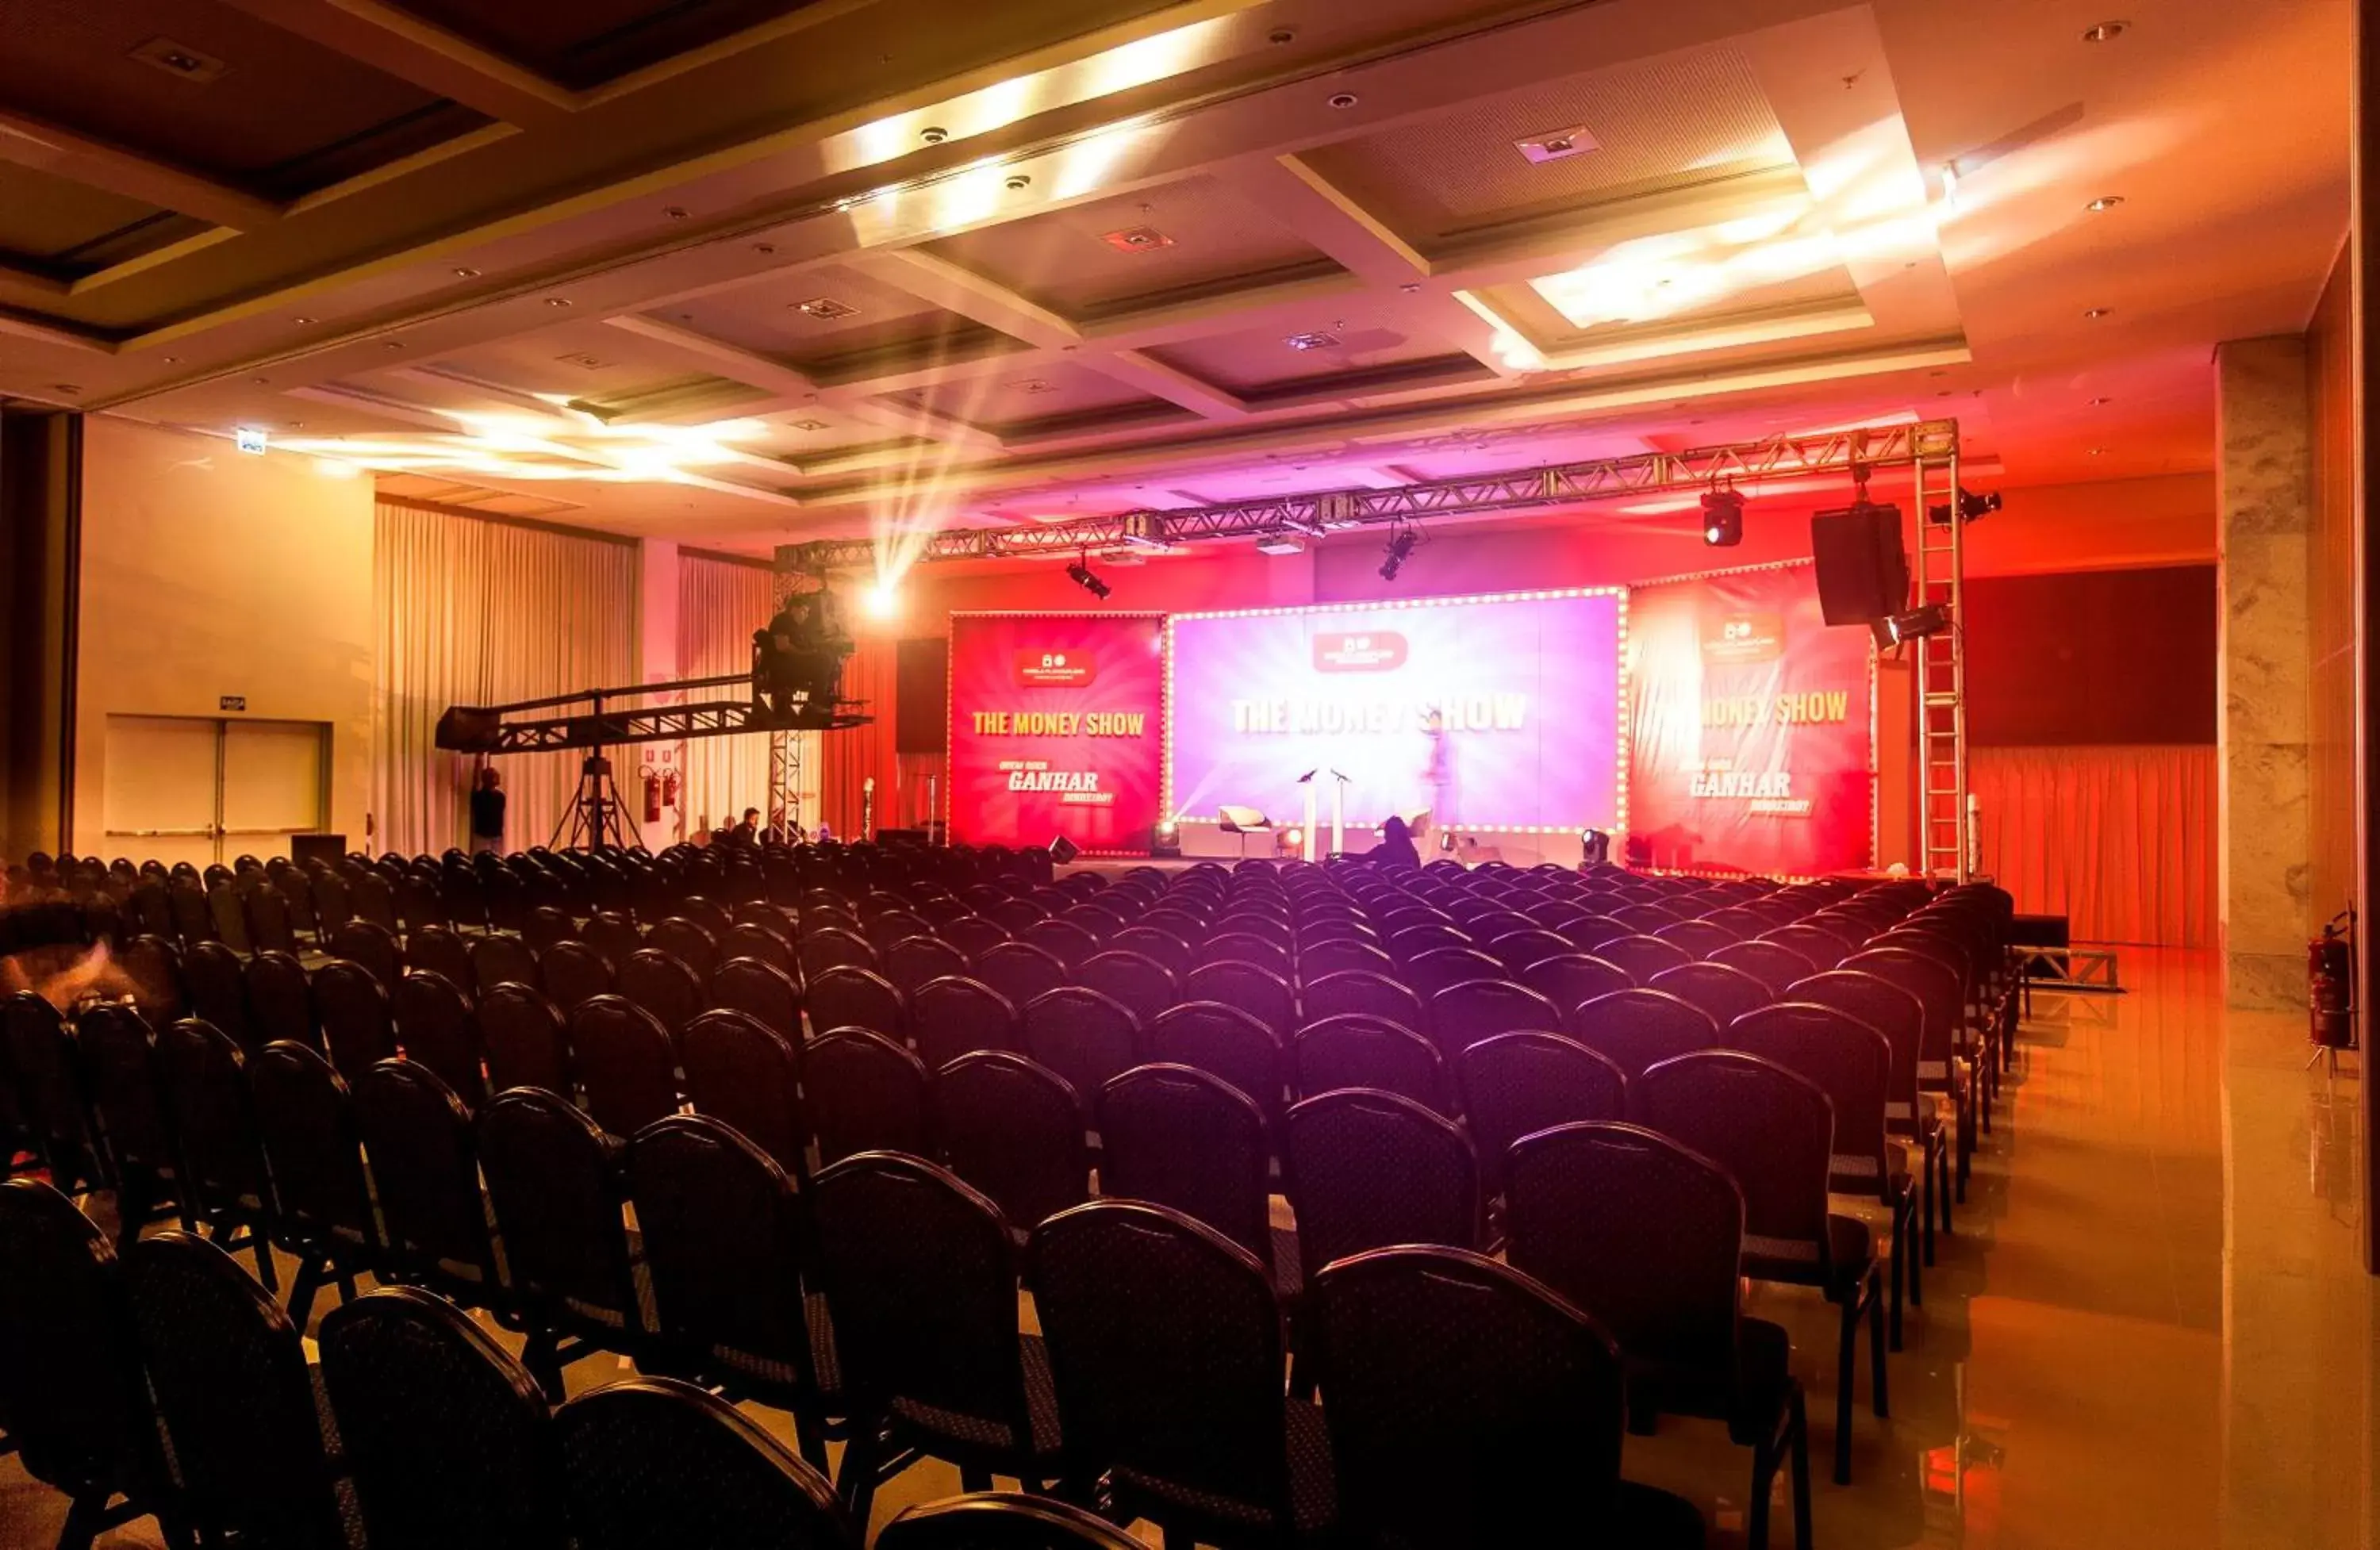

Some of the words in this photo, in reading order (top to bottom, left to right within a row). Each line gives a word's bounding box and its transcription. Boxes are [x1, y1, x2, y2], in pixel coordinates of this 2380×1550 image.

[1231, 697, 1288, 735] THE
[1775, 690, 1847, 724] SHOW
[973, 712, 1010, 735] THE
[1013, 712, 1081, 736] MONEY
[1085, 712, 1146, 738] SHOW
[1008, 771, 1099, 792] GANHAR
[1690, 770, 1791, 797] GANHAR
